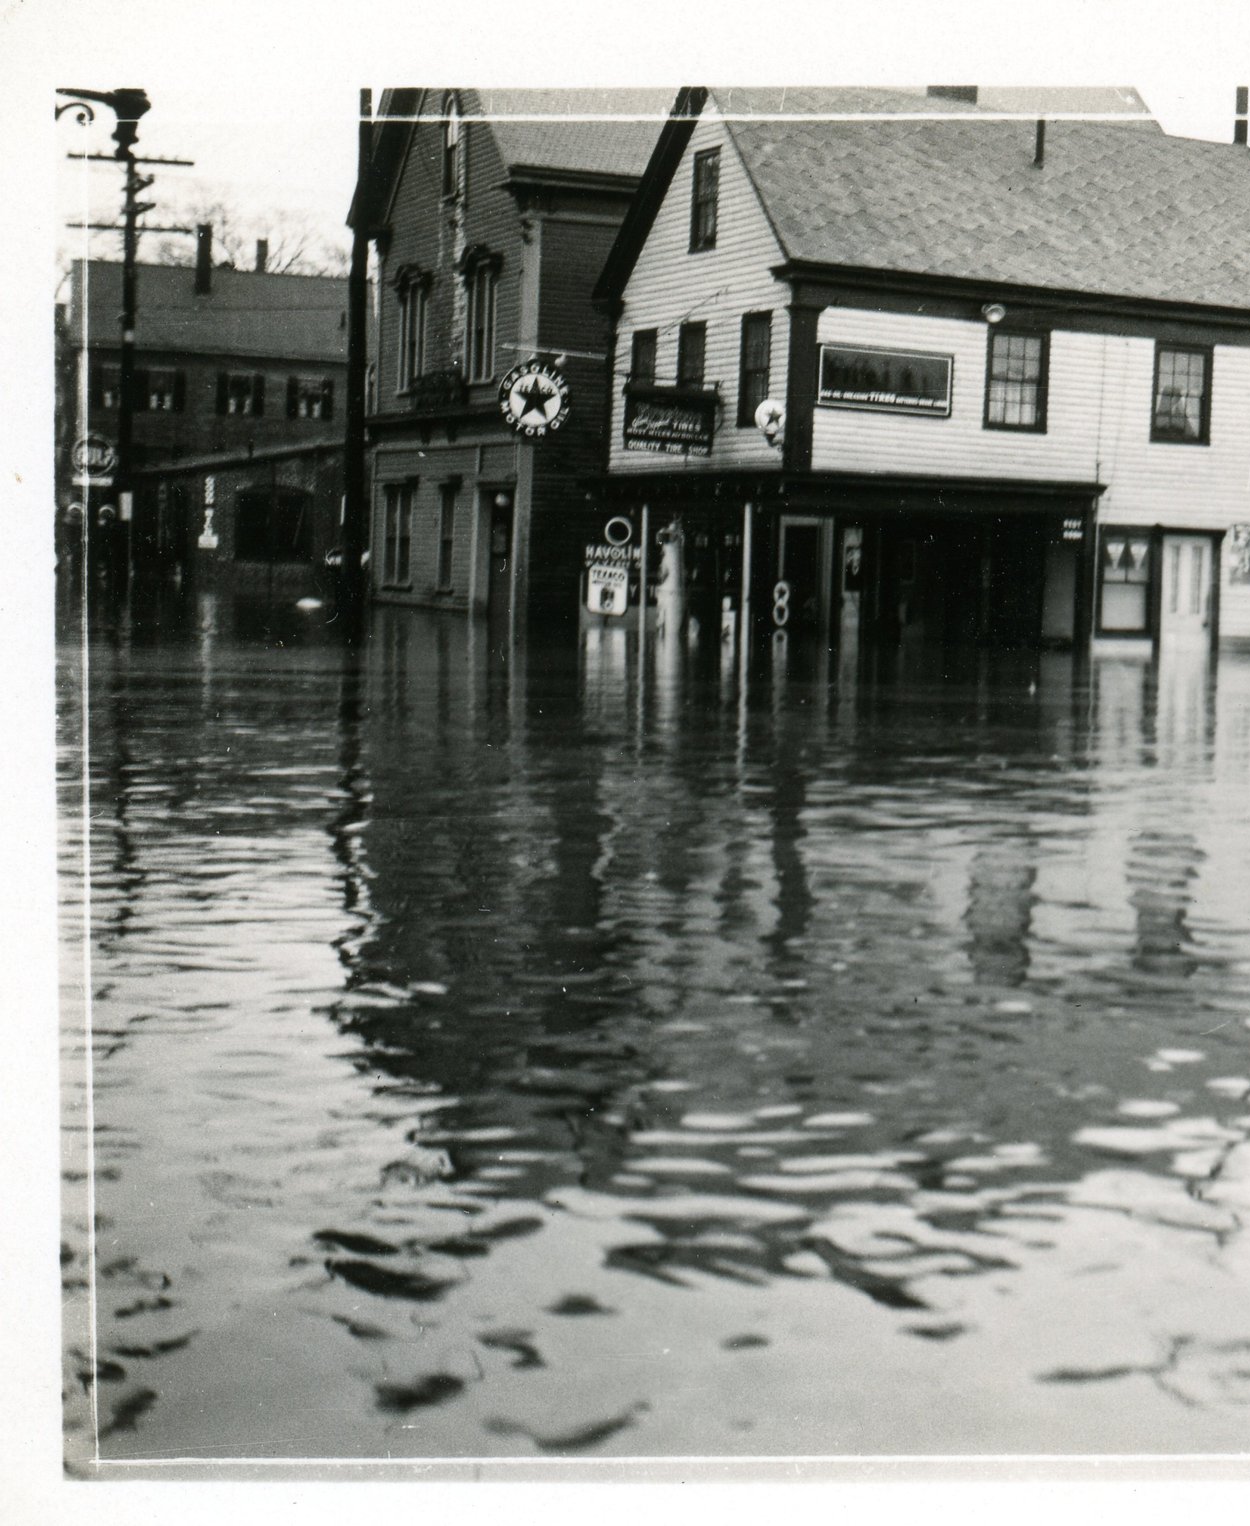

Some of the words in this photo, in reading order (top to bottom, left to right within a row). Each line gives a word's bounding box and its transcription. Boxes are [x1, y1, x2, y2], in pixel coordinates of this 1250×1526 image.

[502, 363, 569, 397] GASOLINE
[869, 391, 896, 404] TIRES
[500, 400, 547, 437] MOTOR
[549, 406, 571, 430] OIL
[627, 439, 661, 453] QUALITY
[665, 442, 683, 454] TIRE
[688, 444, 710, 456] SHOP
[592, 569, 625, 582] TEXACO
